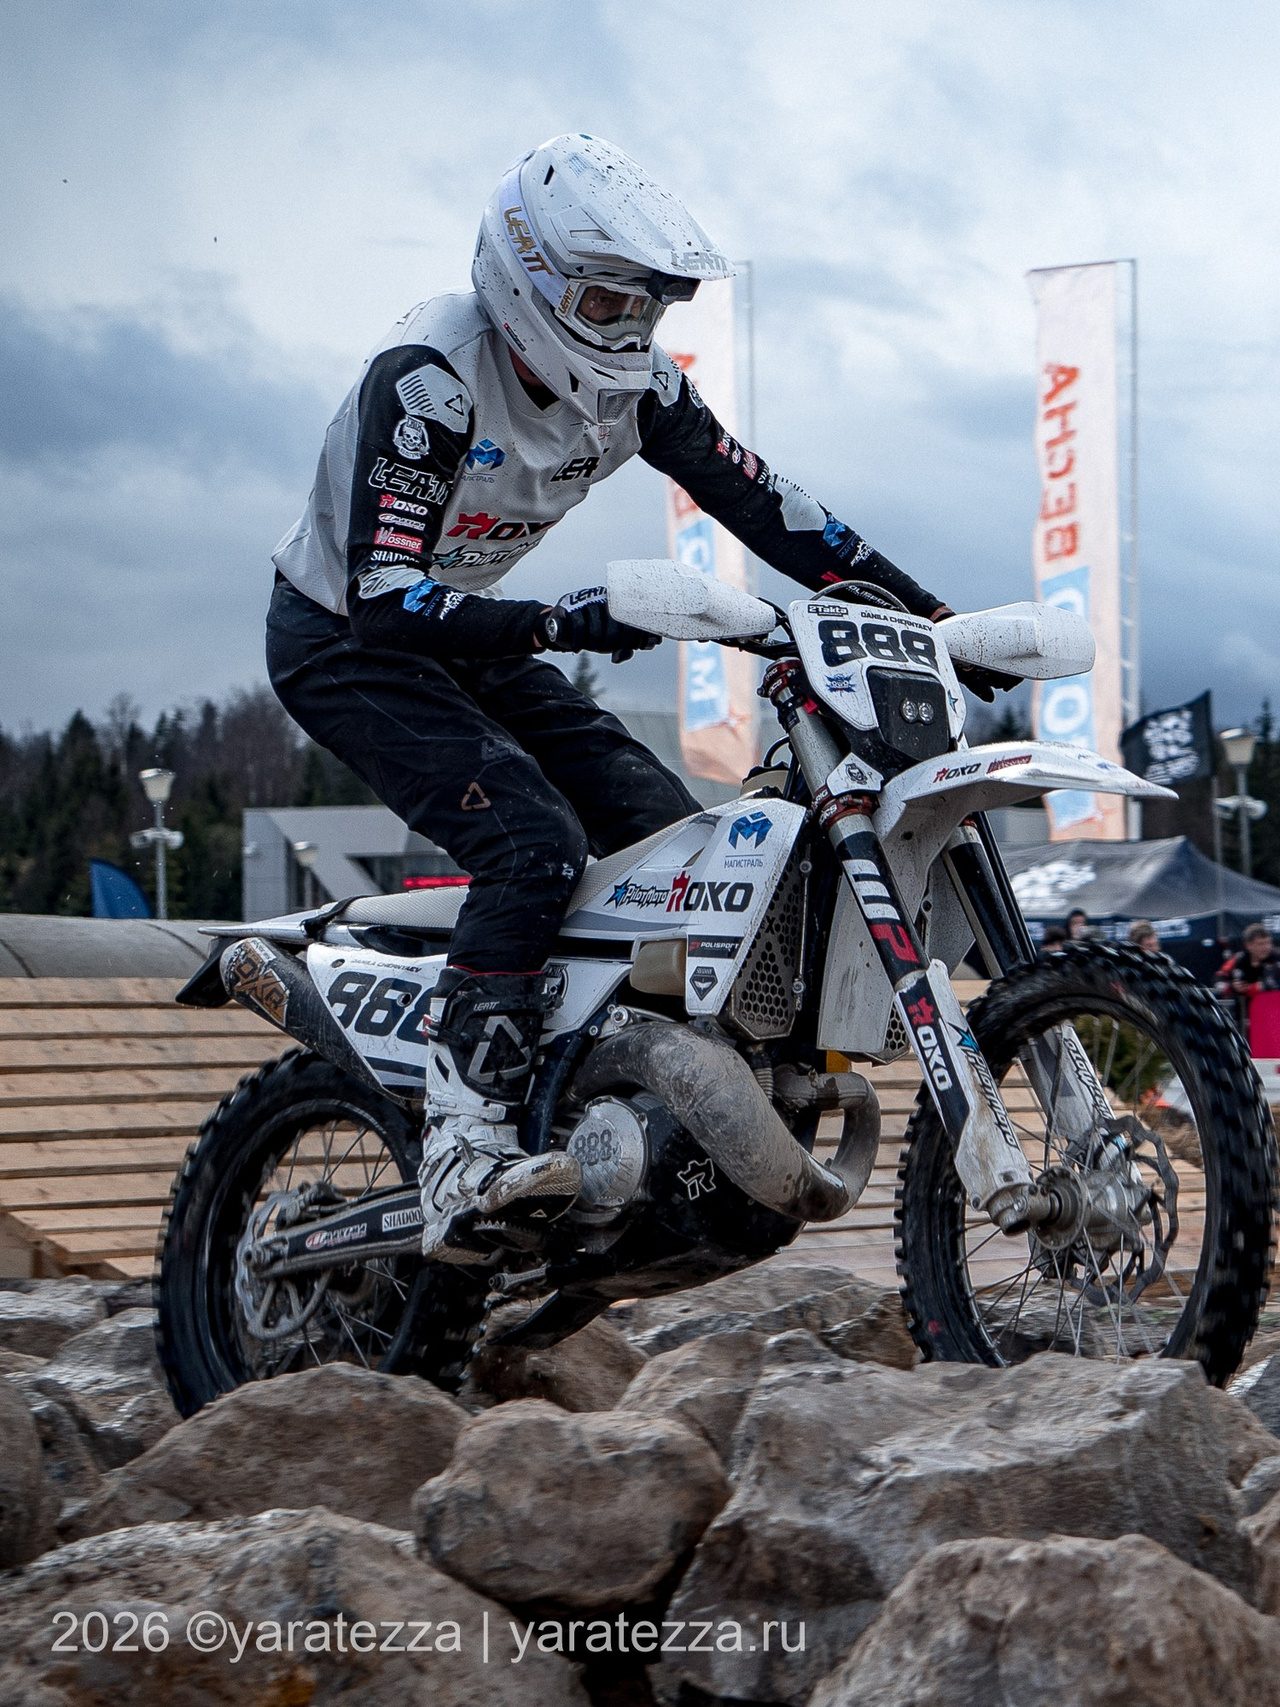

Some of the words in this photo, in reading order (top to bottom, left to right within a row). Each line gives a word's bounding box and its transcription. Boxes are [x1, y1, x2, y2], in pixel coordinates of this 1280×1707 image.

[504, 206, 555, 276] LEATT
[671, 251, 729, 272] LEATT
[558, 284, 575, 316] LEATT
[379, 493, 429, 516] ROXO
[860, 610, 888, 623] DANILA
[818, 619, 940, 674] 888
[933, 762, 982, 784] ROXO
[723, 858, 764, 869] МАГИСТРАЛЬ
[666, 870, 755, 913] ROXO
[700, 941, 740, 950] POLISPORT
[473, 1001, 500, 1012] LEATT
[907, 996, 954, 1092] ROXO
